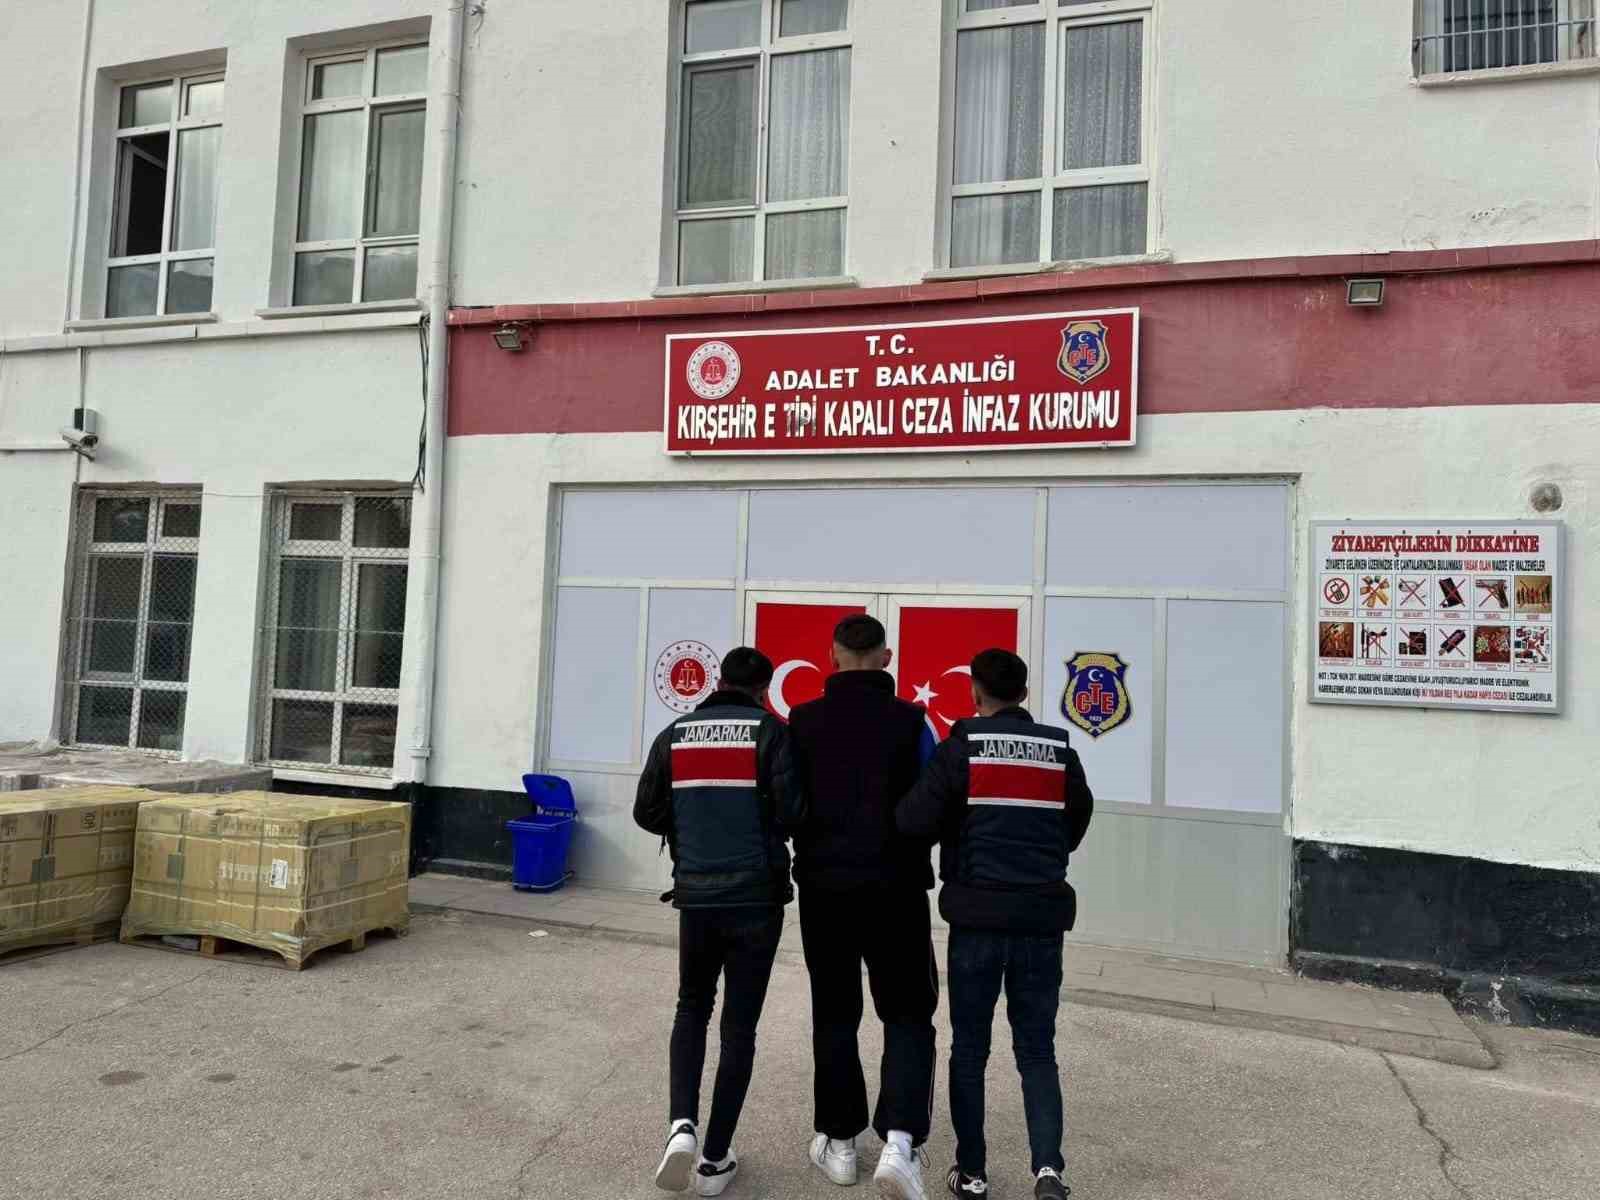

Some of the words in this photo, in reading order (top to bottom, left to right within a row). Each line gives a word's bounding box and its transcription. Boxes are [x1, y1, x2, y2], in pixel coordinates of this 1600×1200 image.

[765, 368, 860, 392] ADALET
[876, 355, 1016, 386] BAKANLIĞI
[677, 396, 757, 445] KIRŞEHİR
[764, 404, 776, 438] E
[784, 396, 817, 437] TİPİ
[824, 401, 894, 437] KAPALI
[901, 399, 953, 435] CEZA
[963, 388, 1020, 434] İNFAZ
[1029, 390, 1121, 431] KURUMU
[1332, 529, 1452, 557] ZİYARETÇİLERİN
[1456, 529, 1540, 553] DİKKATİNE
[680, 725, 752, 743] JANDARMA
[979, 740, 1057, 762] JANDARMA
